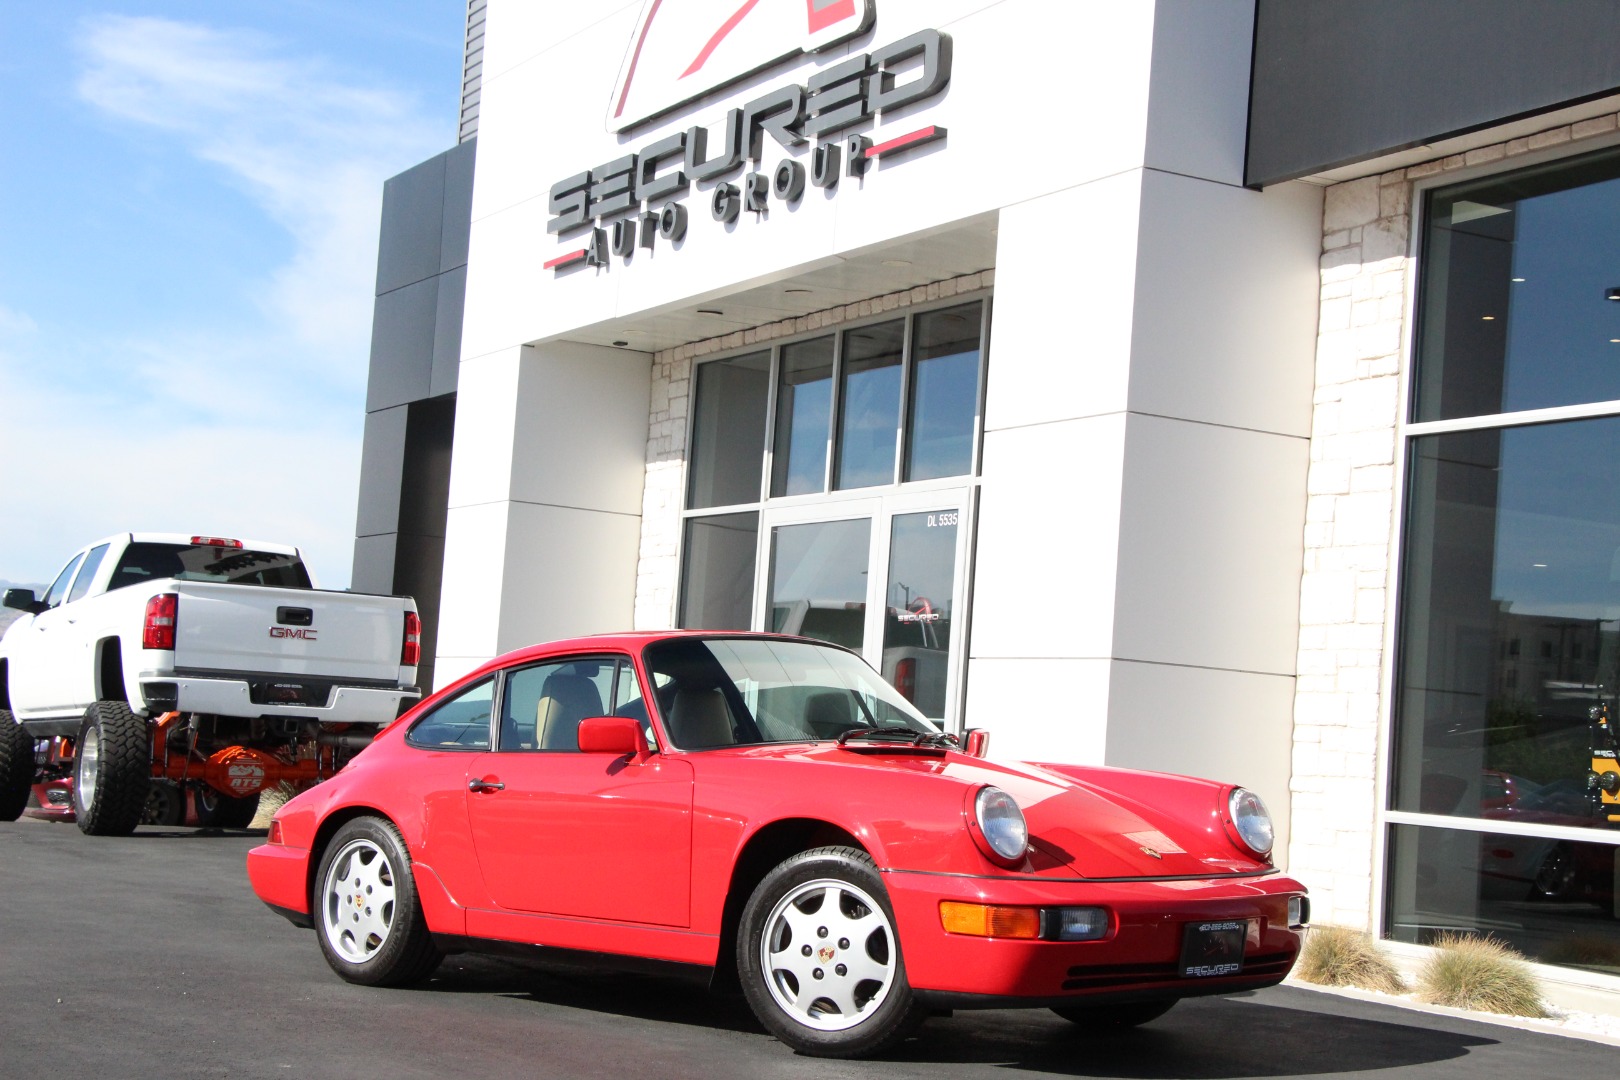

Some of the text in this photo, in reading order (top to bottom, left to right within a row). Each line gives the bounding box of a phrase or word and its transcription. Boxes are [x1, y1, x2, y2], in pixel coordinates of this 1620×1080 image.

[547, 27, 953, 236] SECURED
[586, 133, 875, 269] AUTO GROUP
[927, 512, 958, 528] DL 5535
[269, 626, 318, 641] GMC
[230, 778, 262, 788] ATS
[1186, 963, 1239, 975] SECURED
